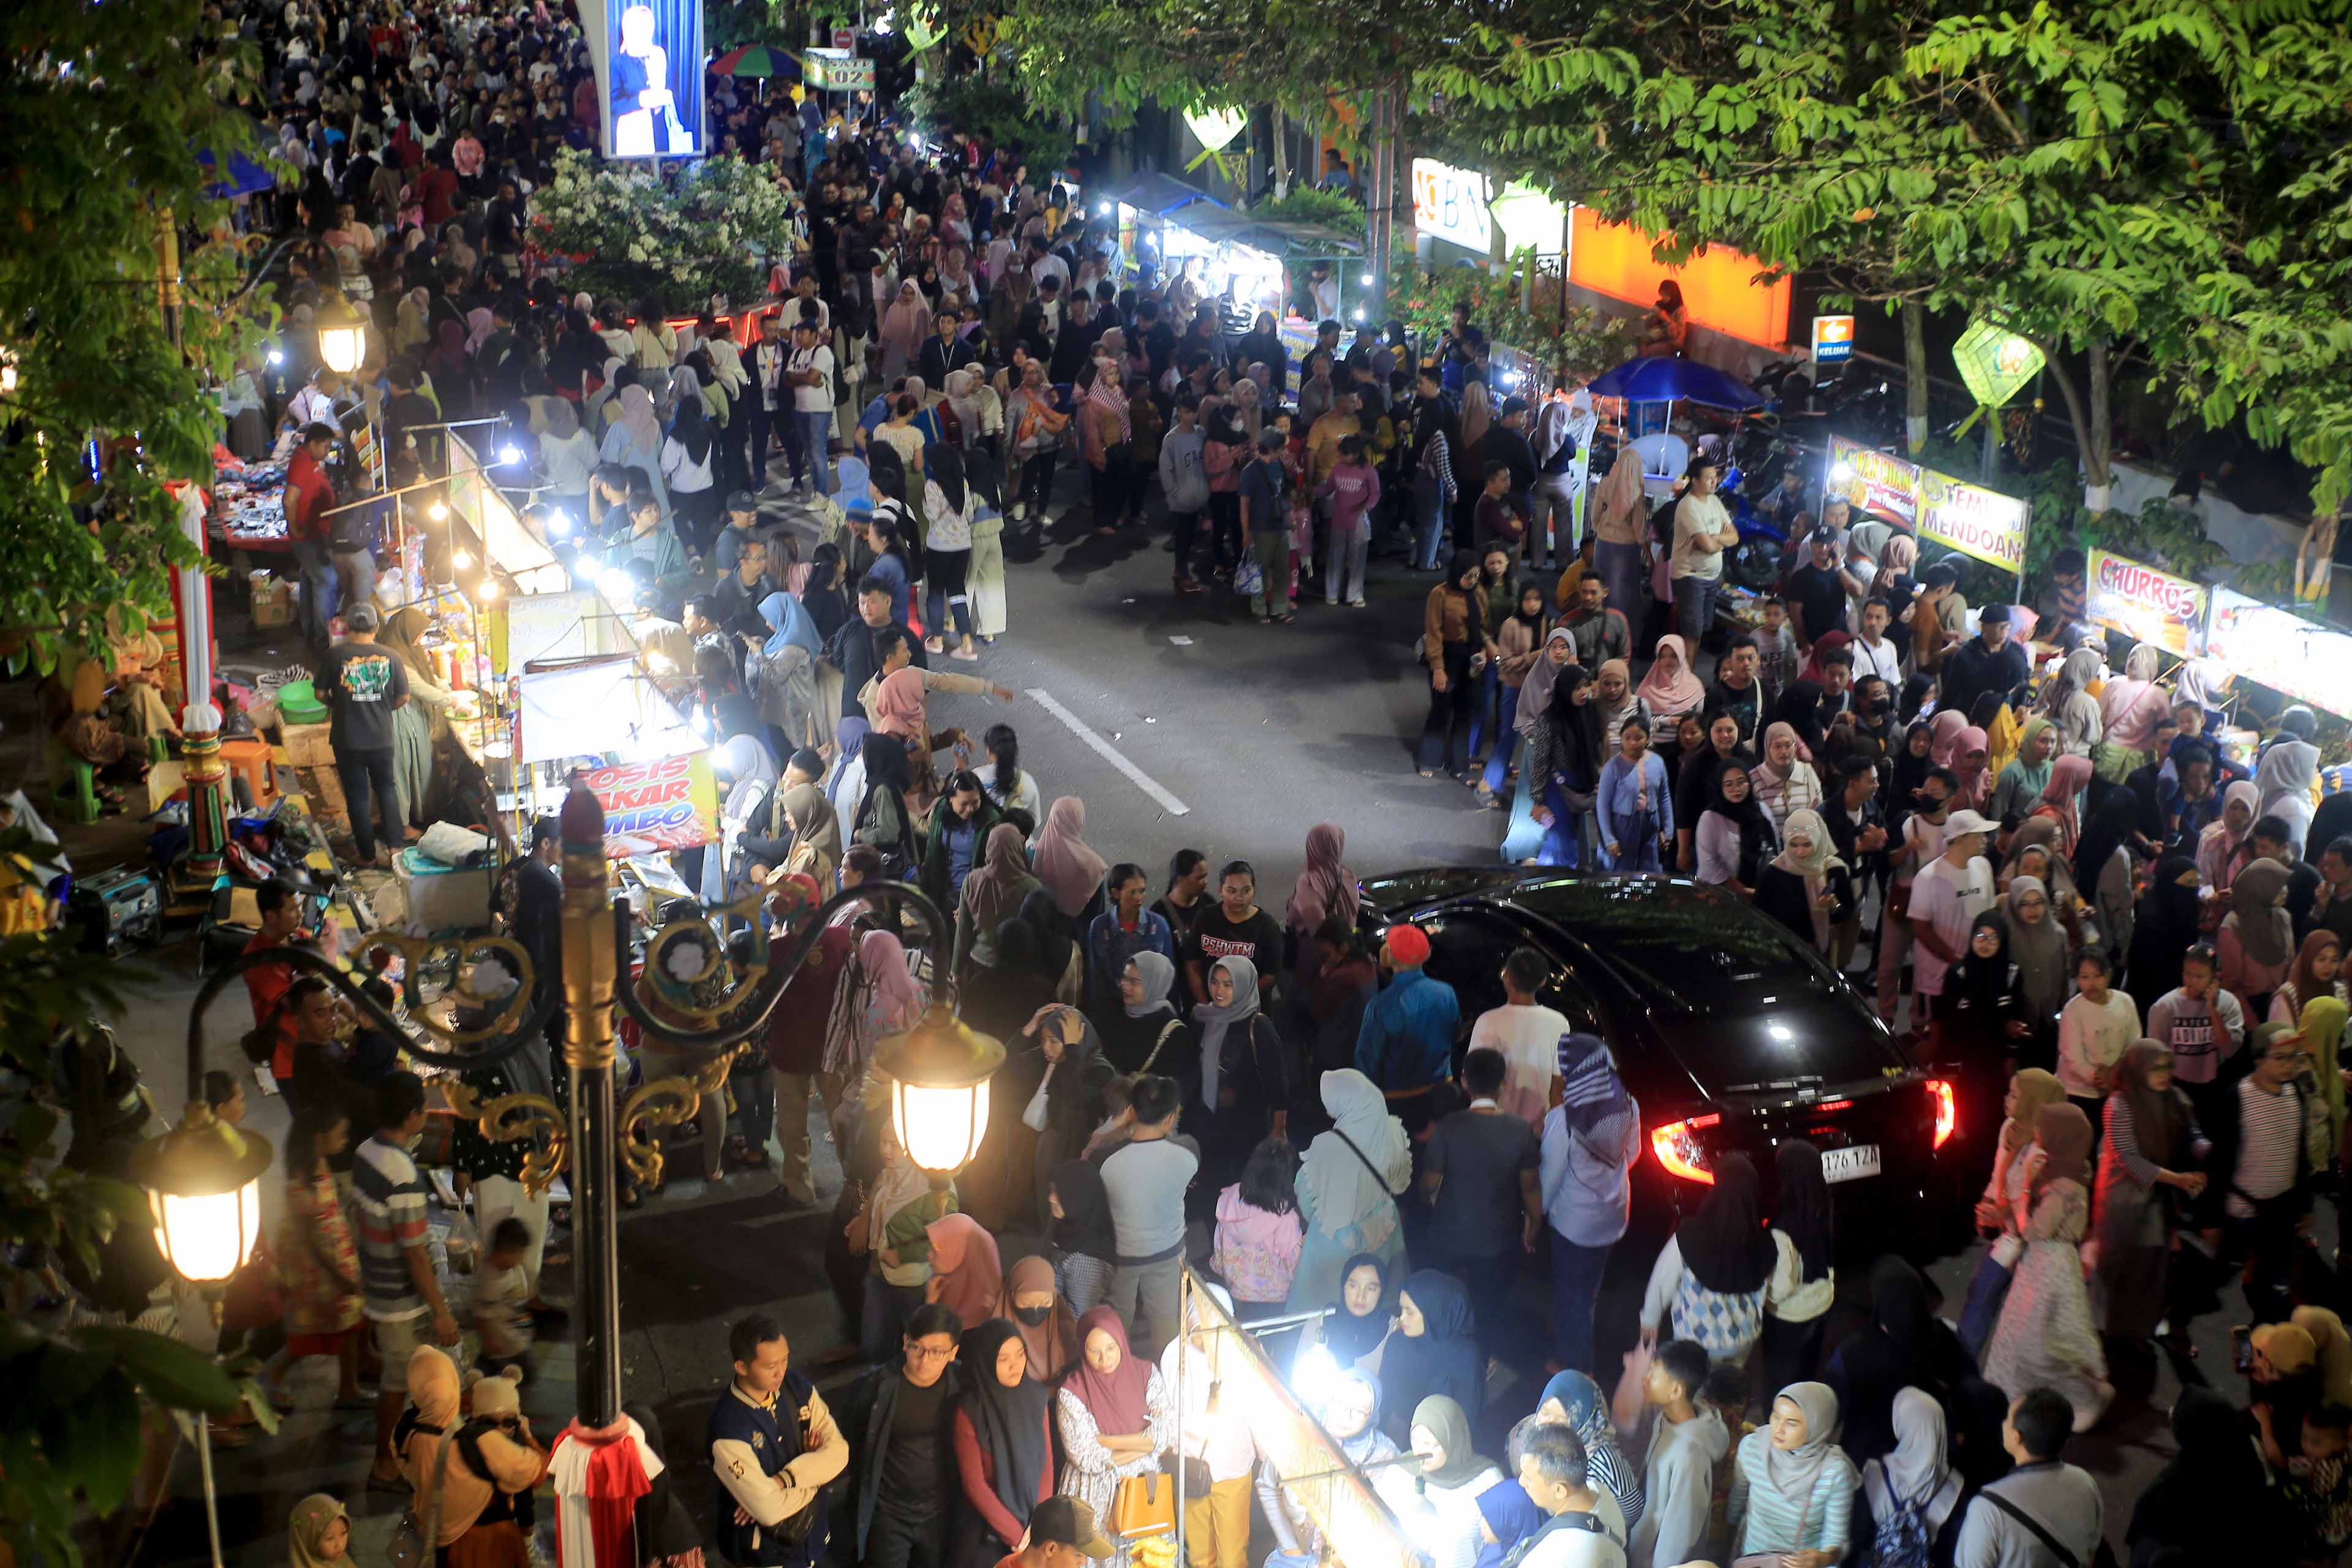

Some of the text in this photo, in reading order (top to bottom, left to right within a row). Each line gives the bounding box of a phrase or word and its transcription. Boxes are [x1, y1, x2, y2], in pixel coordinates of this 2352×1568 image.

[1945, 484, 1991, 516] TEM
[1923, 508, 2021, 564] MENDOAN
[2100, 557, 2196, 617] CHURROS
[587, 756, 689, 788] OSIS
[598, 780, 691, 812] AKAR
[604, 804, 693, 834] MBO
